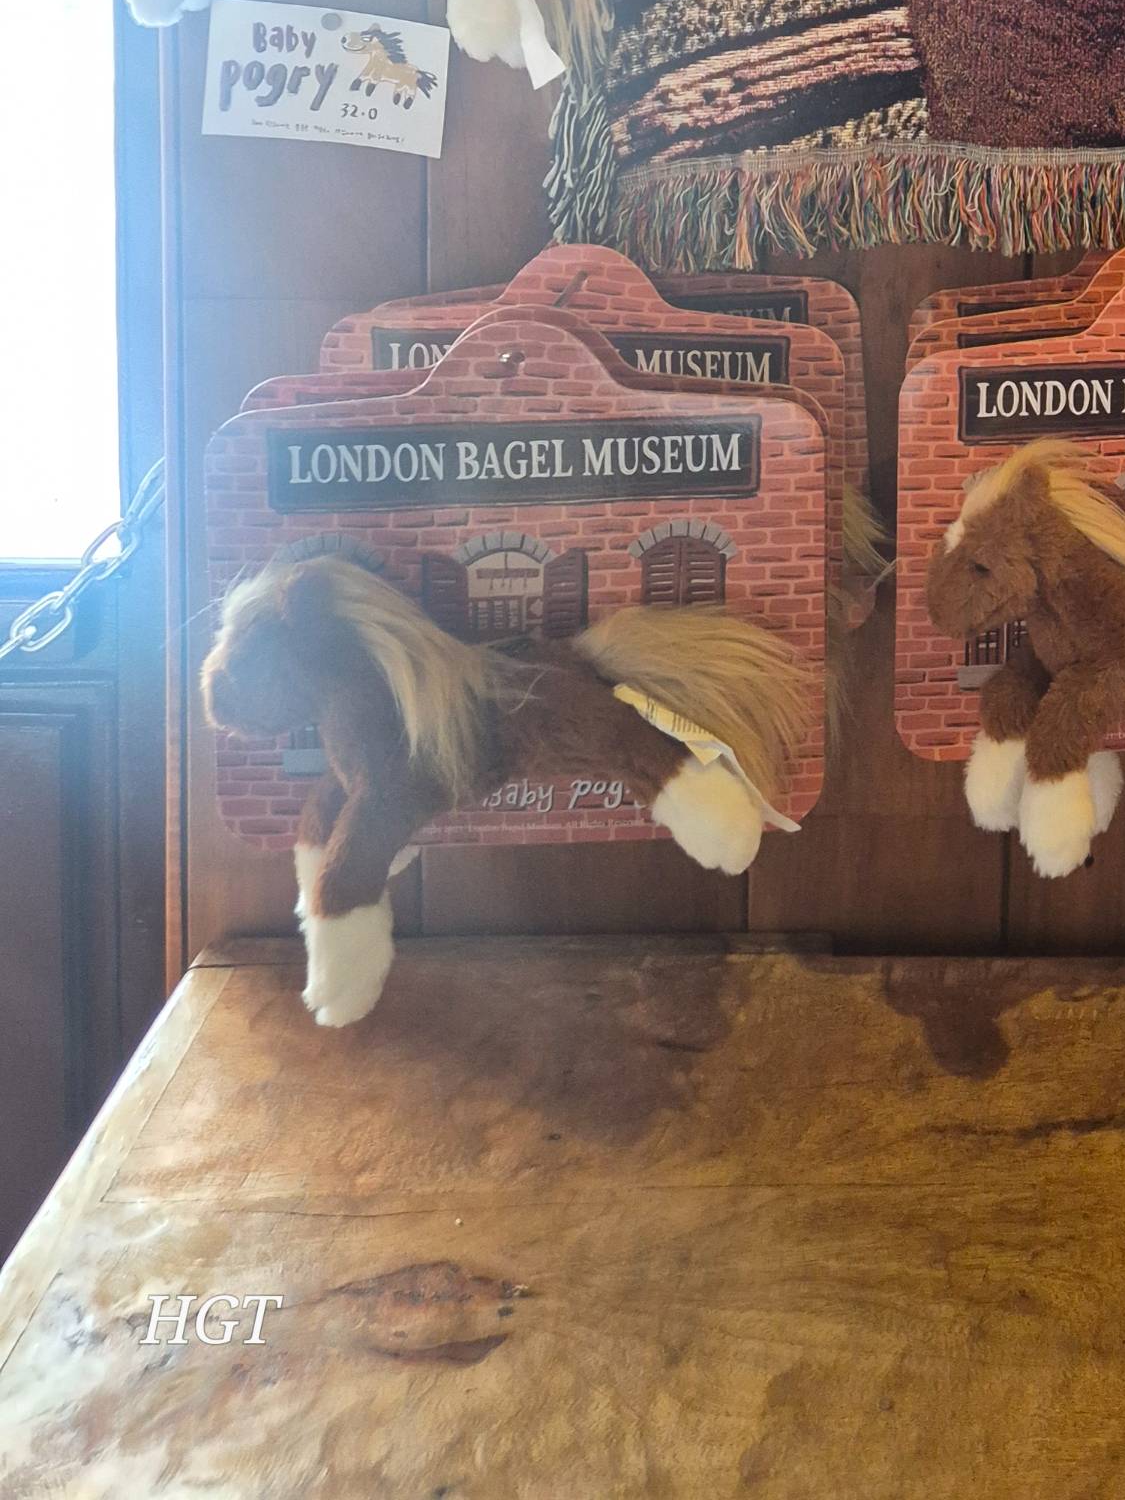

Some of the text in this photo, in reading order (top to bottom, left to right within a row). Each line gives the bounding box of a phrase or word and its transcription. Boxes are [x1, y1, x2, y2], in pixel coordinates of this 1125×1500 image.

[252, 21, 317, 58] Baby
[635, 349, 772, 384] MUSEUM
[976, 379, 1114, 419] LONDON
[288, 433, 742, 484] LONDON BAGEL MUSEUM
[567, 778, 647, 810] pog
